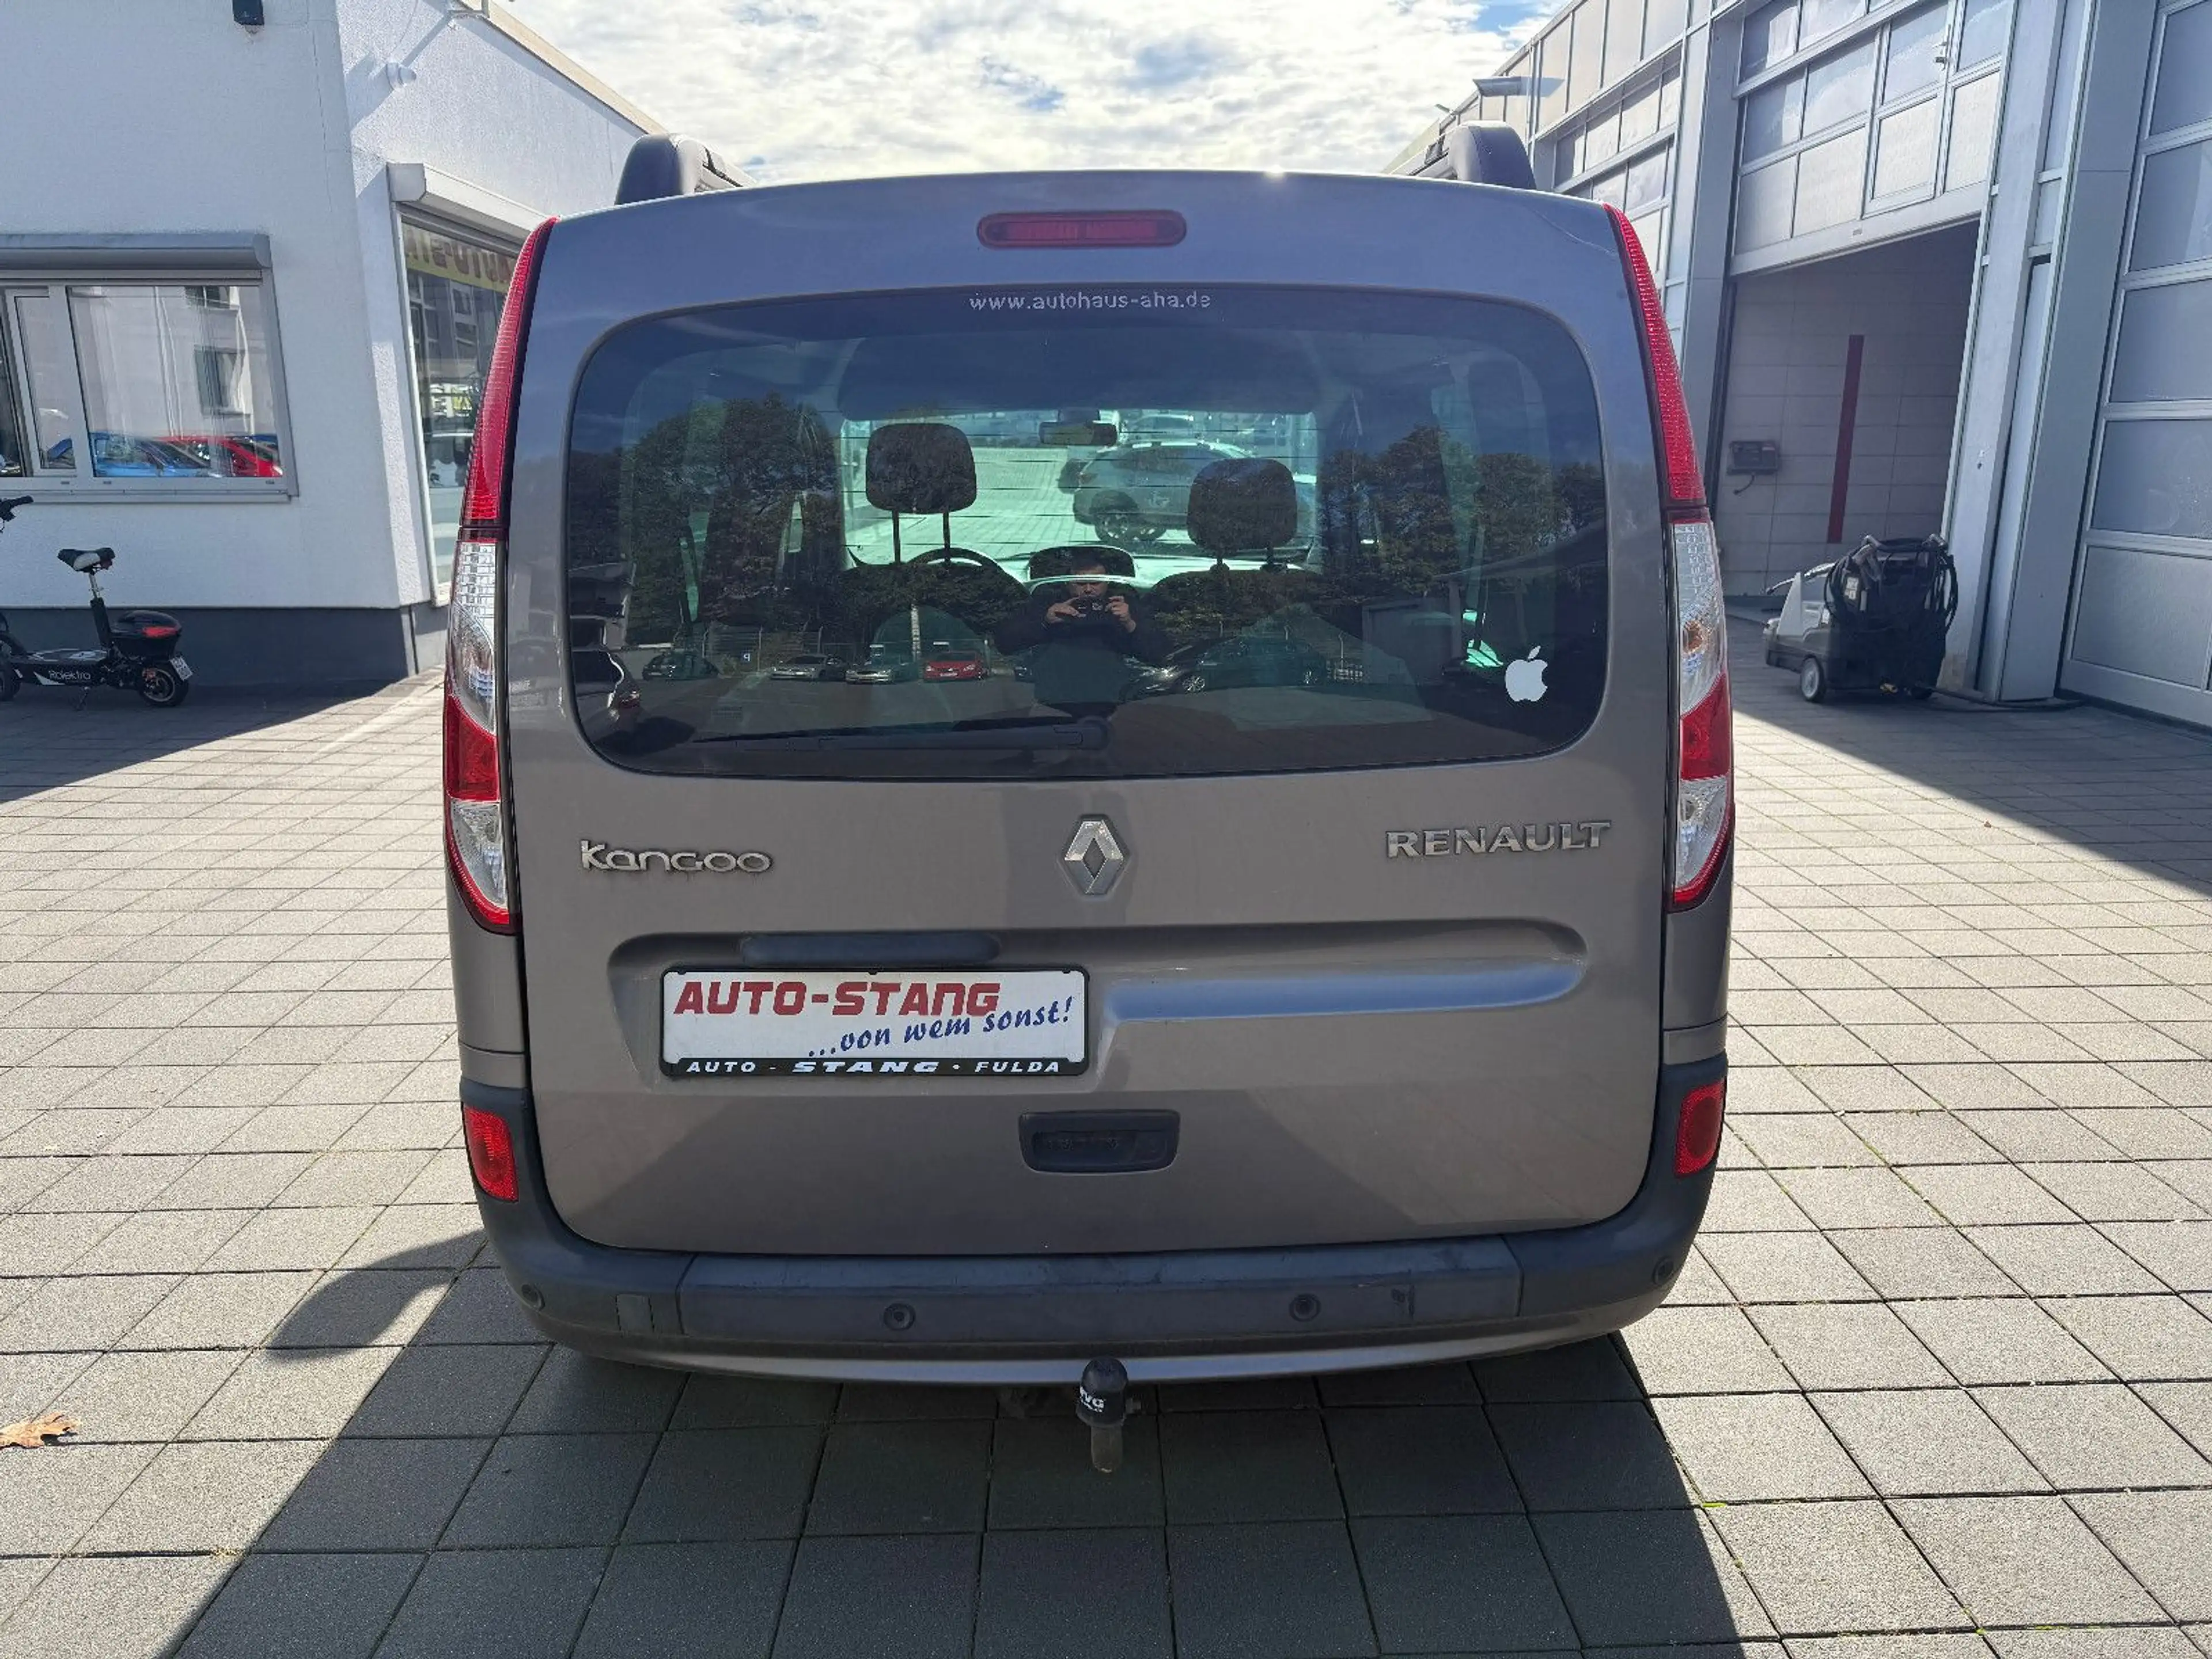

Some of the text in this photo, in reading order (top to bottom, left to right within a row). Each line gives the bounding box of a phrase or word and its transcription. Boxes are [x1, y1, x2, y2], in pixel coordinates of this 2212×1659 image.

[969, 291, 1211, 310] www.autohaus-aha.de
[579, 839, 773, 873] Kangoo
[1385, 820, 1612, 858] RENAULT
[673, 981, 1001, 1016] AUTO-STANG
[808, 995, 1074, 1058] ...von wem sonst!
[685, 1061, 756, 1073] AUTO
[792, 1061, 940, 1073] STANG
[974, 1061, 1059, 1073] FULDA
